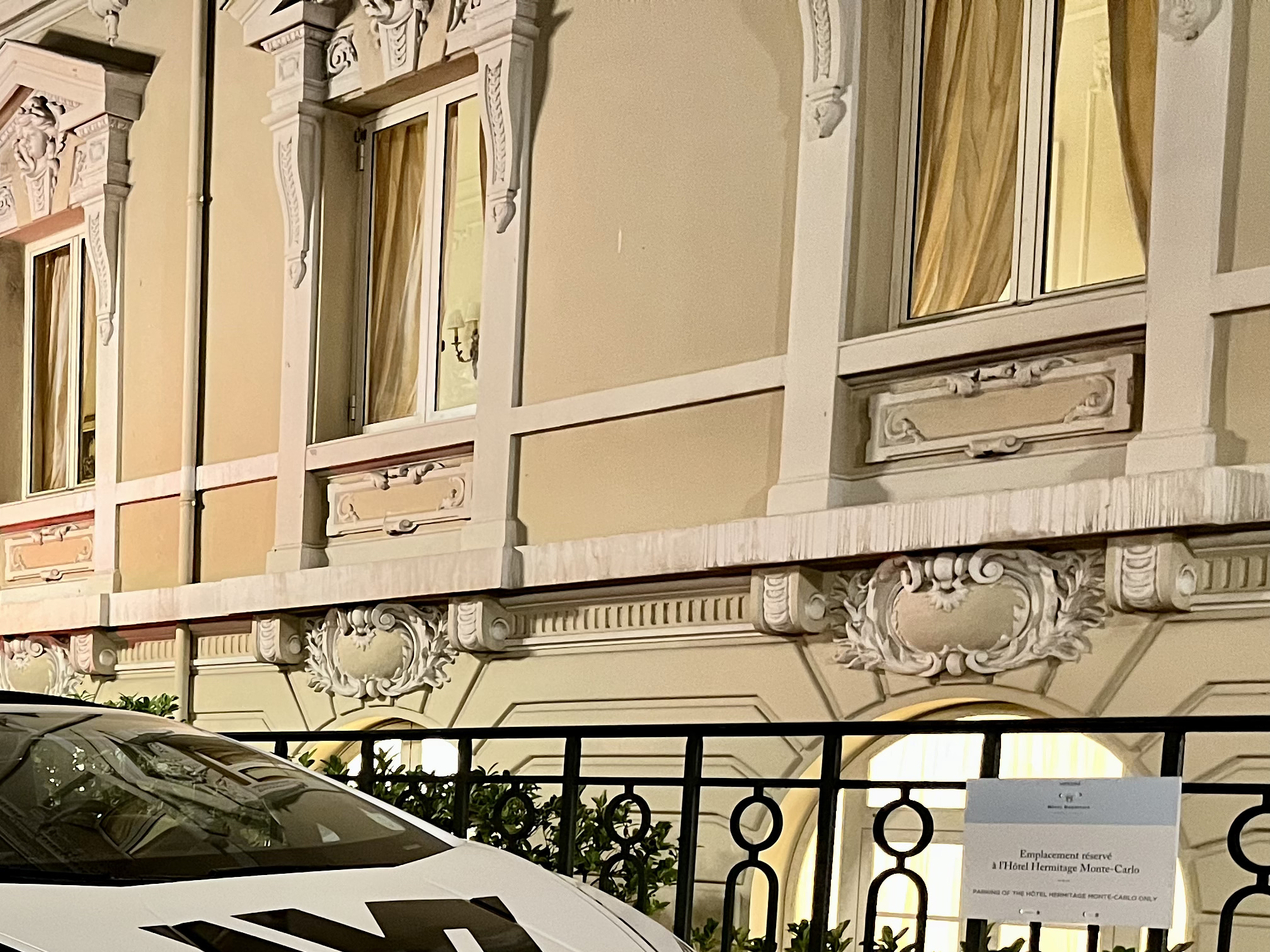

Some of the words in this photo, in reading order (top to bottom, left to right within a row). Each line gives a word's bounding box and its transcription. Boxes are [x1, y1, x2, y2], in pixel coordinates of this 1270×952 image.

[1020, 849, 1079, 861] Emplacement
[1081, 851, 1113, 861] réservé
[991, 862, 997, 870] à
[999, 860, 1029, 871] l'Hôtel
[1031, 862, 1078, 874] Hermitage
[1079, 863, 1141, 875] Monte-Carlo
[972, 888, 1001, 896] PARKING
[1048, 891, 1087, 899] HERMITAGE
[1087, 893, 1138, 902] MONTE-CARLO
[1138, 895, 1158, 903] ONLY
